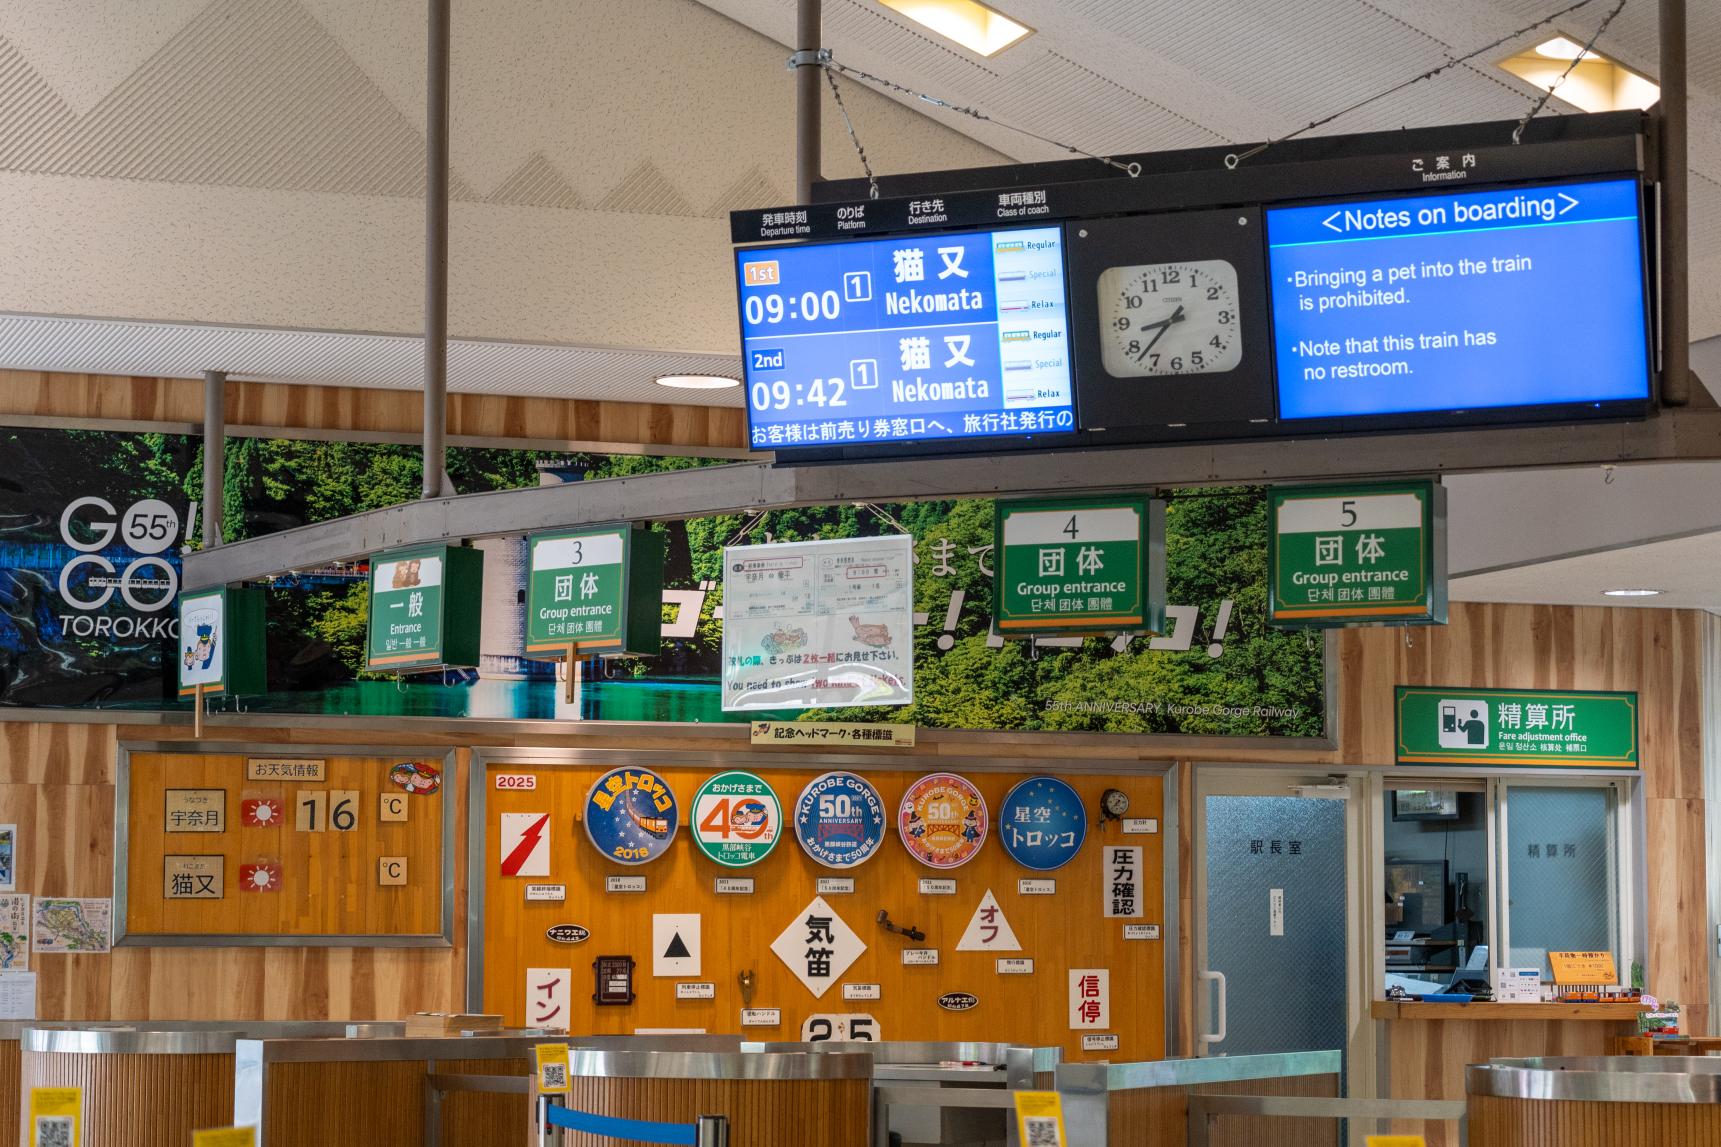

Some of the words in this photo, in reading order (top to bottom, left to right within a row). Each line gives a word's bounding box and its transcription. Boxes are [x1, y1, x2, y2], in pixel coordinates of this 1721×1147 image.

[1411, 153, 1476, 172] ご案内
[1422, 169, 1467, 183] Information
[998, 190, 1046, 206] 車両種別
[837, 205, 865, 219] のりば
[909, 199, 945, 214] 行き先
[997, 208, 1018, 218] Class
[1018, 207, 1027, 215] of
[1027, 204, 1050, 215] coach
[762, 210, 807, 226] 発車時刻
[908, 213, 948, 225] Destination
[1417, 206, 1447, 227] on
[760, 227, 795, 238] Departure
[795, 225, 811, 234] time
[837, 220, 866, 230] Platform
[1027, 240, 1056, 251] Regular
[892, 245, 970, 283] 猫又
[1295, 267, 1367, 289] Bringing
[1371, 268, 1384, 282] a
[1388, 263, 1417, 287] pet
[1421, 260, 1454, 280] into
[1458, 257, 1487, 275] the
[1492, 254, 1532, 273] train
[749, 266, 775, 281] 1st
[1028, 269, 1057, 280] Special
[1161, 270, 1181, 284] 12
[1189, 274, 1198, 288] 1
[1141, 279, 1159, 293] 11
[1206, 287, 1220, 301] 2
[745, 290, 840, 325] 09:00
[850, 276, 862, 298] 1
[885, 287, 984, 316] Nekomata
[1031, 300, 1054, 309] Relax
[1124, 295, 1143, 309] 10
[1299, 292, 1314, 311] is
[1318, 287, 1411, 314] prohibited.
[1117, 317, 1131, 331] 9
[1218, 310, 1230, 325] 3
[1033, 329, 1062, 341] Regular
[1208, 335, 1223, 348] 4
[1299, 339, 1341, 358] Note
[1345, 336, 1379, 355] that
[1383, 333, 1415, 352] this
[1418, 330, 1459, 350] train
[1463, 327, 1497, 347] has
[899, 334, 976, 371] 猫又
[1128, 340, 1141, 354] 8
[754, 351, 783, 369] 2nd
[1035, 358, 1063, 370] Special
[1149, 353, 1161, 367] 7
[1170, 357, 1183, 371] 6
[1191, 350, 1204, 365] 5
[1303, 365, 1326, 381] no
[1330, 359, 1414, 379] restroom.
[751, 377, 847, 411] 09:42
[857, 363, 868, 385] 1
[891, 377, 989, 404] Nekomata
[1037, 389, 1061, 398] Relax
[751, 409, 1074, 445] お客様は前売り券窓口へ、旅行社発行の
[1340, 500, 1357, 528] 5
[129, 513, 176, 541] 55th
[1062, 514, 1080, 540] 4
[572, 540, 583, 565] 3
[1315, 533, 1386, 567] 団体
[1038, 545, 1105, 577] 団体
[554, 571, 599, 602] 団体
[1292, 571, 1339, 587] Group
[1342, 570, 1409, 583] entrance
[1017, 582, 1060, 598] Group
[1063, 581, 1126, 594] entrance
[1307, 588, 1334, 602] 단체
[1338, 587, 1364, 601] 团体
[389, 591, 424, 618] 一般
[539, 607, 569, 621] Group
[570, 604, 612, 617] entrance
[1031, 597, 1056, 612] 단체
[1059, 598, 1084, 612] 团体
[390, 623, 422, 635] Entrance
[548, 622, 565, 636] 단체
[566, 621, 584, 634] 团体
[727, 680, 744, 691] You
[771, 680, 782, 689] to
[1044, 700, 1073, 712] 55th
[1074, 701, 1162, 714] ANNIVERSARY
[1167, 704, 1210, 716] Kurobe
[1212, 704, 1251, 717] Gorge
[1253, 705, 1300, 719] Railway
[1498, 702, 1576, 731] 精算所
[774, 727, 893, 741] 記念ヘッドマーク・各種標識
[1498, 731, 1517, 740] Fare
[1517, 732, 1563, 742] adjustment
[1564, 732, 1587, 742] office
[255, 763, 319, 777] お天気情報
[497, 776, 535, 788] 2025
[712, 783, 763, 794] おかげさまで
[592, 771, 673, 813] 星空トロッコ
[801, 778, 844, 815] KUROBE
[846, 778, 880, 815] GORGE
[819, 794, 863, 818] 50th
[170, 809, 219, 827] 宇奈月
[302, 799, 356, 832] 16
[1013, 805, 1052, 824] 星空
[1011, 827, 1076, 849] トロッコ
[613, 847, 650, 860] 2018
[1250, 839, 1303, 855] 駅長室
[171, 872, 216, 896] 猫又
[1112, 848, 1136, 916] 圧力確認
[979, 904, 999, 944] オフ
[804, 914, 835, 977] 気笛
[536, 977, 561, 1023] イン
[1078, 975, 1101, 1024] 信停
